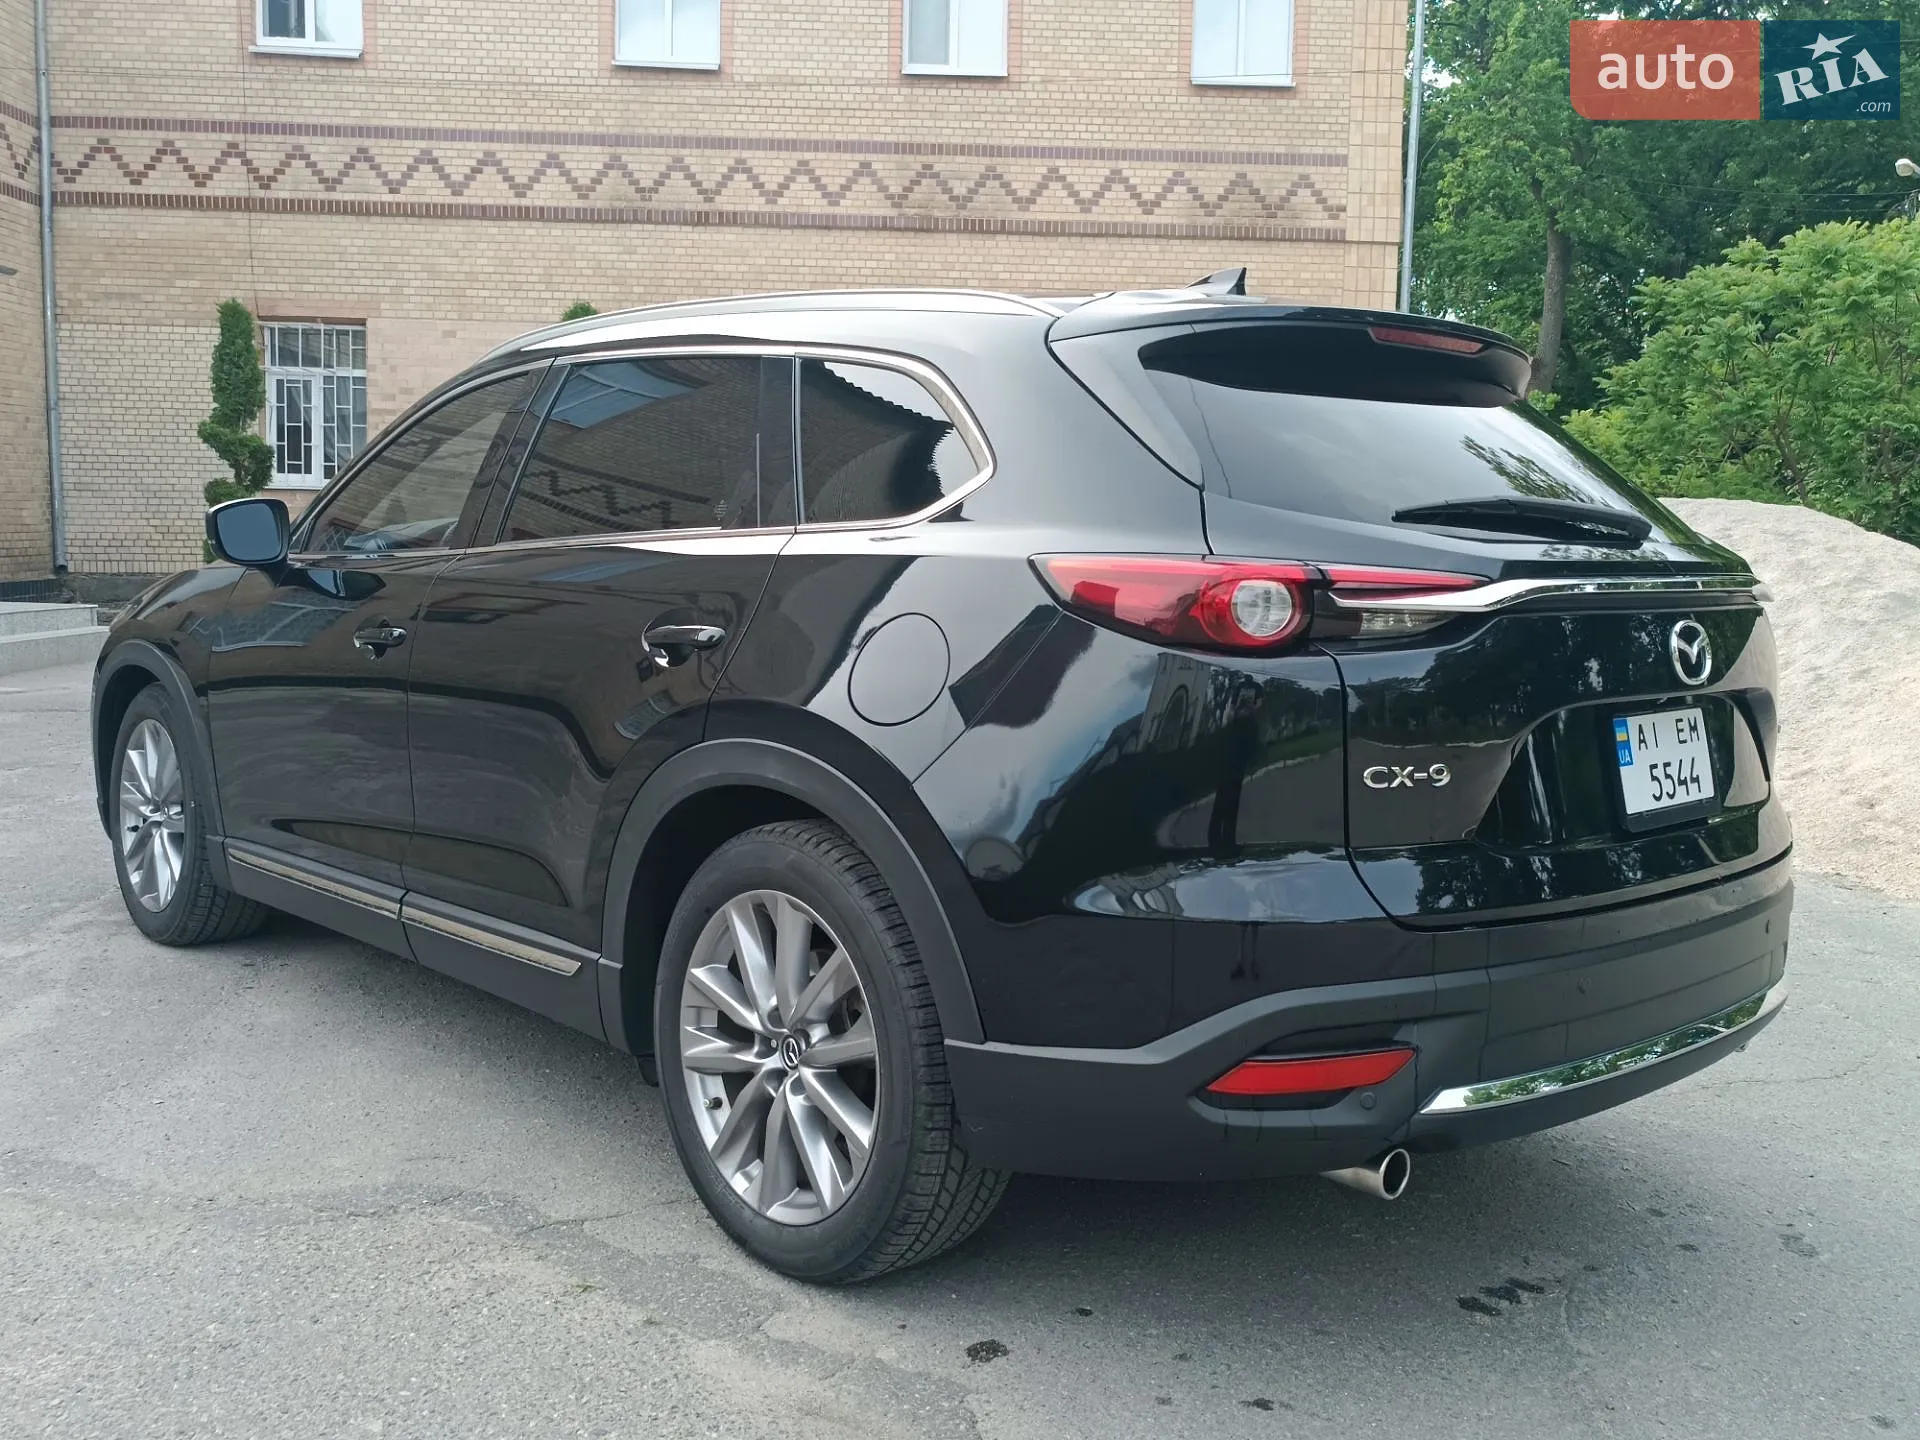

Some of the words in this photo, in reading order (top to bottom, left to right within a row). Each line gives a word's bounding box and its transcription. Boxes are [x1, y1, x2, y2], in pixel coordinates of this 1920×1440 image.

[1638, 722, 1658, 751] AI
[1674, 716, 1700, 744] EM
[1618, 748, 1632, 764] UA
[1363, 763, 1452, 789] CX-9
[1649, 757, 1701, 802] 5544
